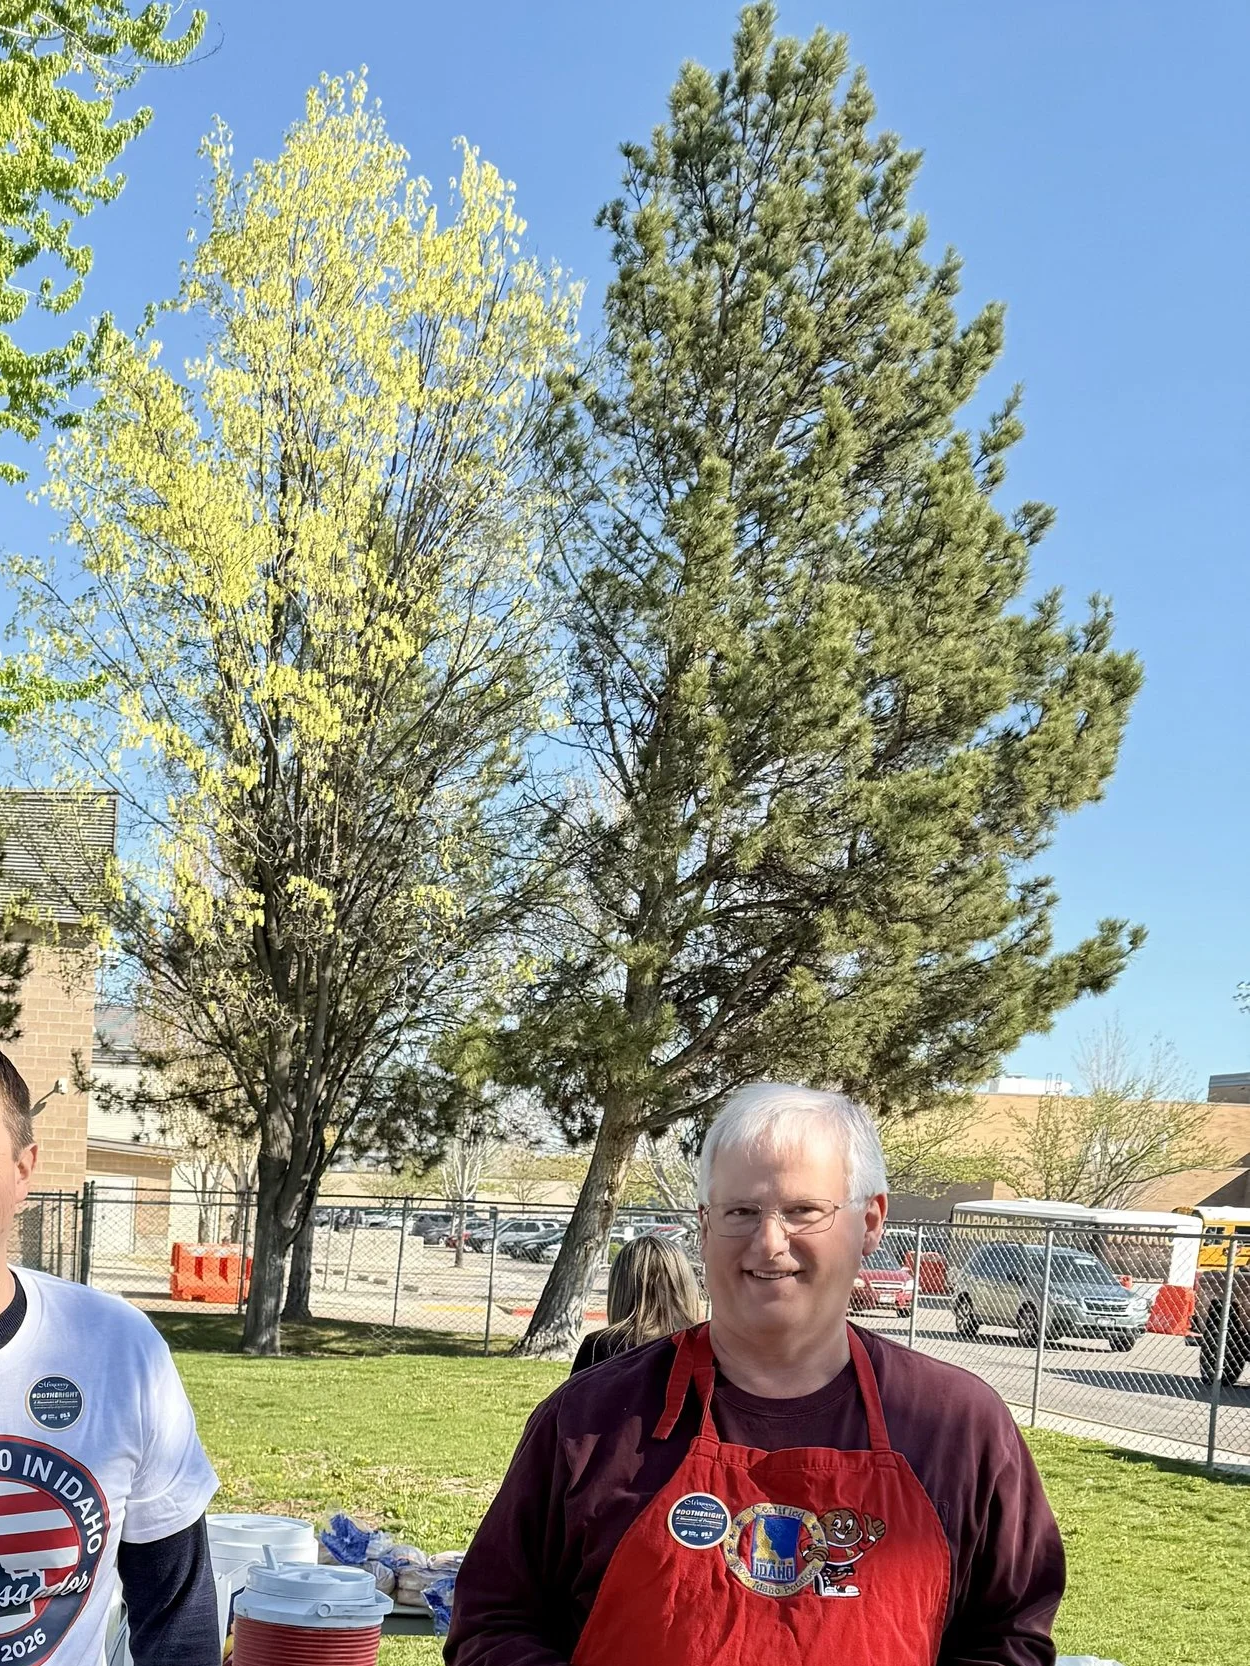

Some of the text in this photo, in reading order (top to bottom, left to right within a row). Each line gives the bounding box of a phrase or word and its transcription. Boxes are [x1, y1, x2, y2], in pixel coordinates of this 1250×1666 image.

[21, 1453, 54, 1483] IN
[52, 1469, 103, 1555] IDAHO
[752, 1506, 805, 1518] Certified
[755, 1563, 794, 1580] IDAHO
[752, 1580, 781, 1595] Idaho
[0, 1627, 47, 1662] 2026
